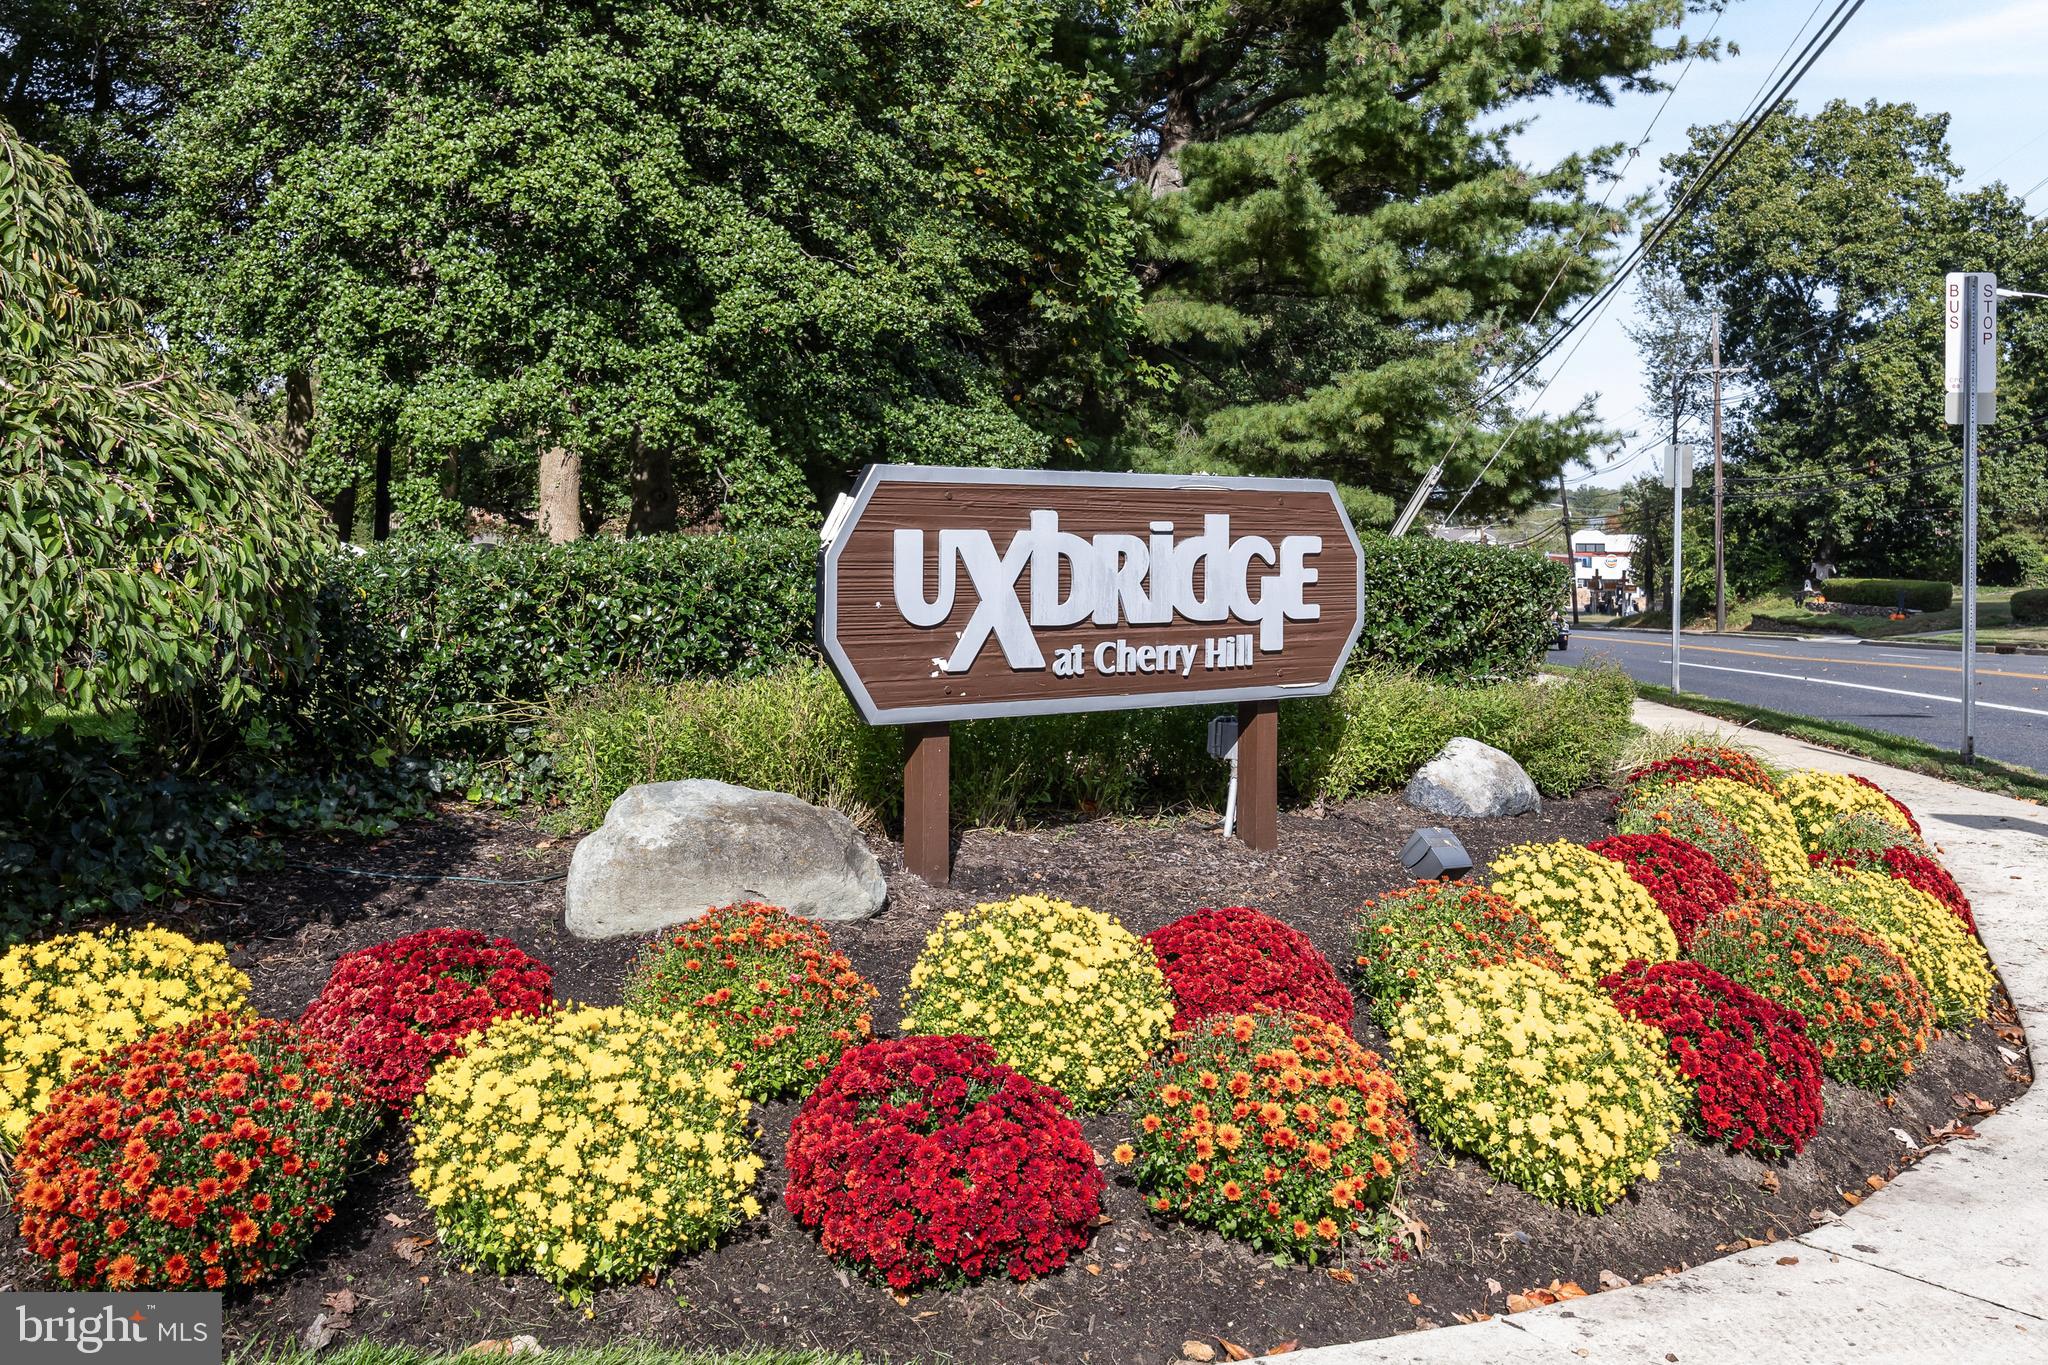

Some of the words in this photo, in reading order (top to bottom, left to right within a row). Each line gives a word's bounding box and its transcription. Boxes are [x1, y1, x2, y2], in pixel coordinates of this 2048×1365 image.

[1949, 284, 1959, 329] BUS
[1983, 284, 1993, 345] STOP
[1052, 643, 1085, 678] at
[1093, 639, 1198, 678] Cherry
[1204, 634, 1254, 670] Hill
